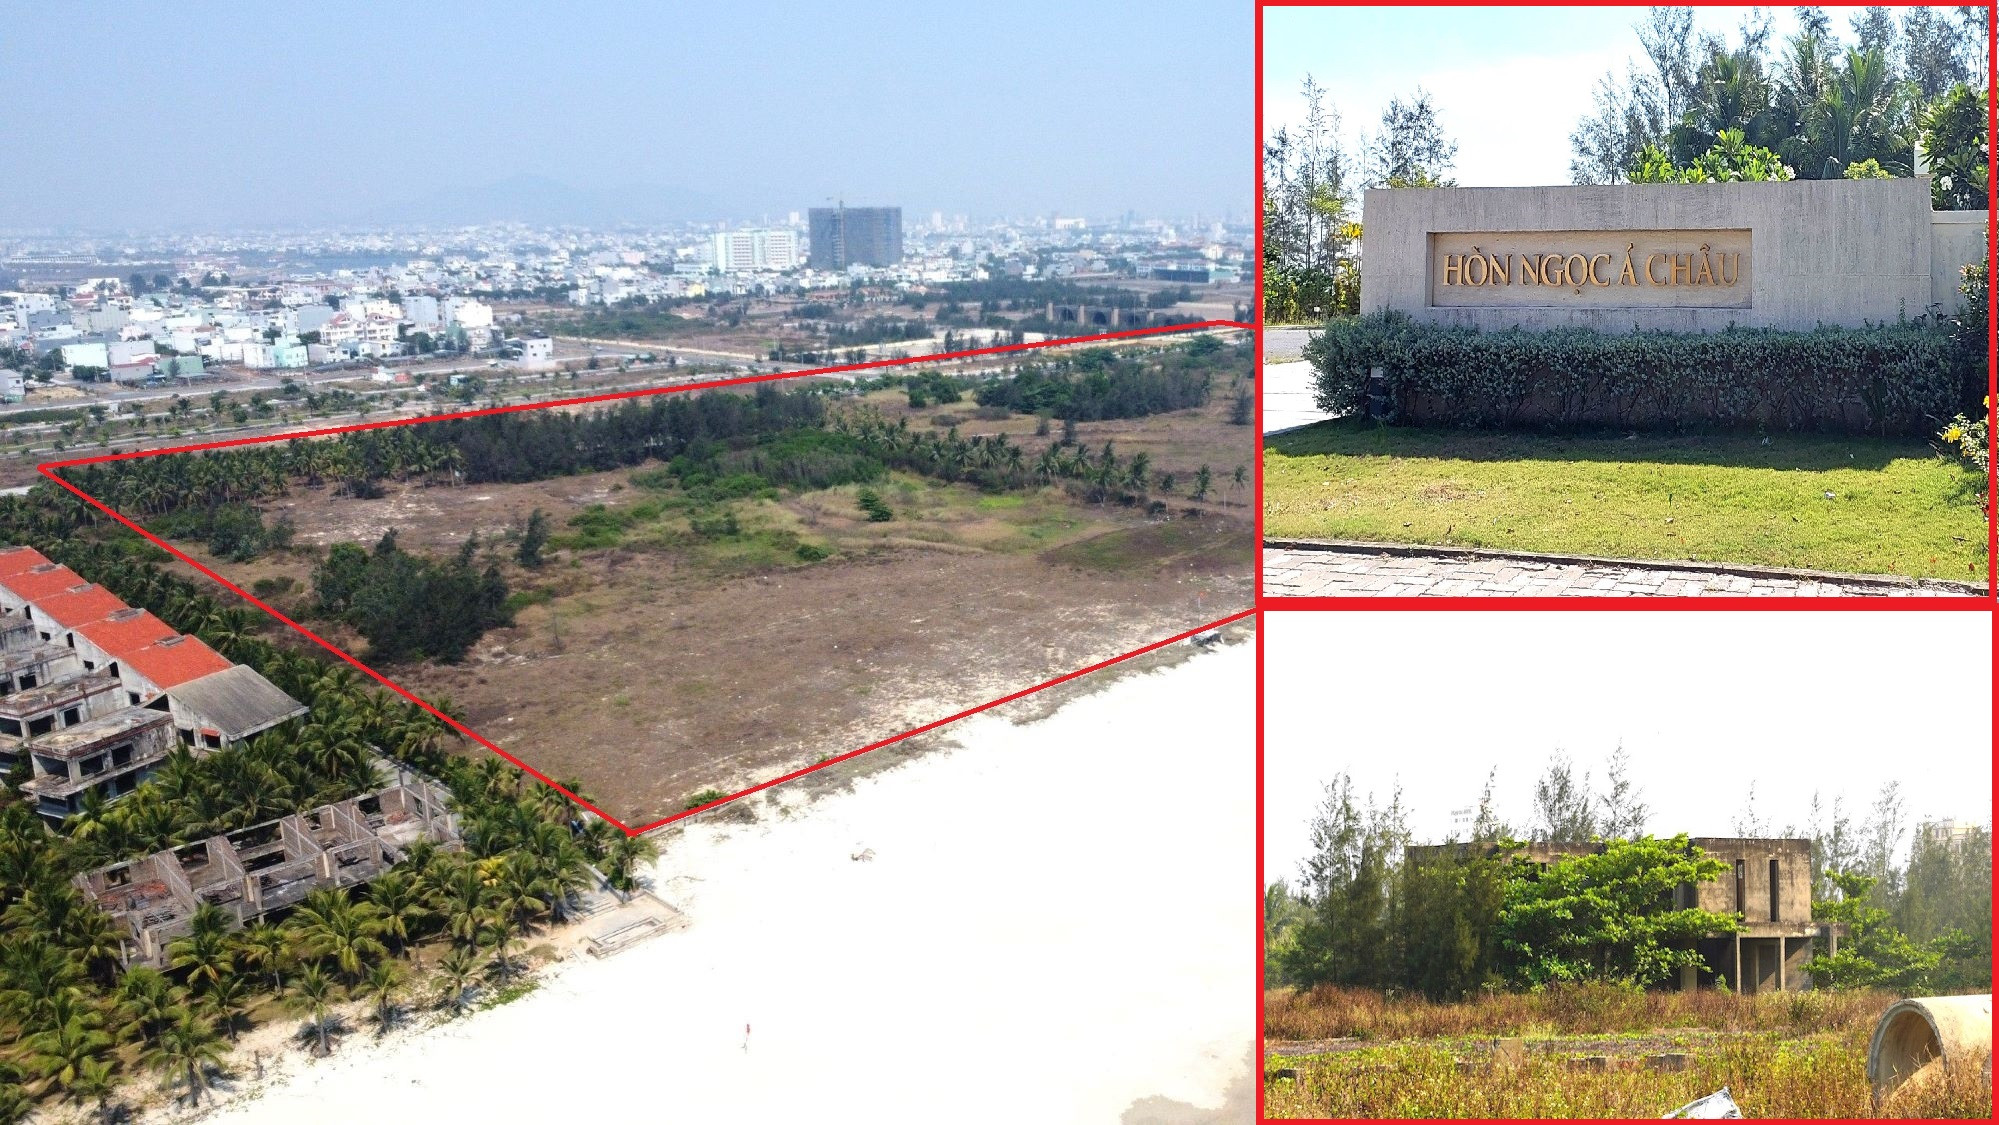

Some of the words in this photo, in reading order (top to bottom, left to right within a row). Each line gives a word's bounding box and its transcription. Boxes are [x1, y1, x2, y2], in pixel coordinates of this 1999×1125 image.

[1443, 246, 1512, 286] HÒN
[1519, 253, 1612, 296] NGỌC
[1617, 242, 1640, 286] Á
[1644, 243, 1741, 287] CHÂU
